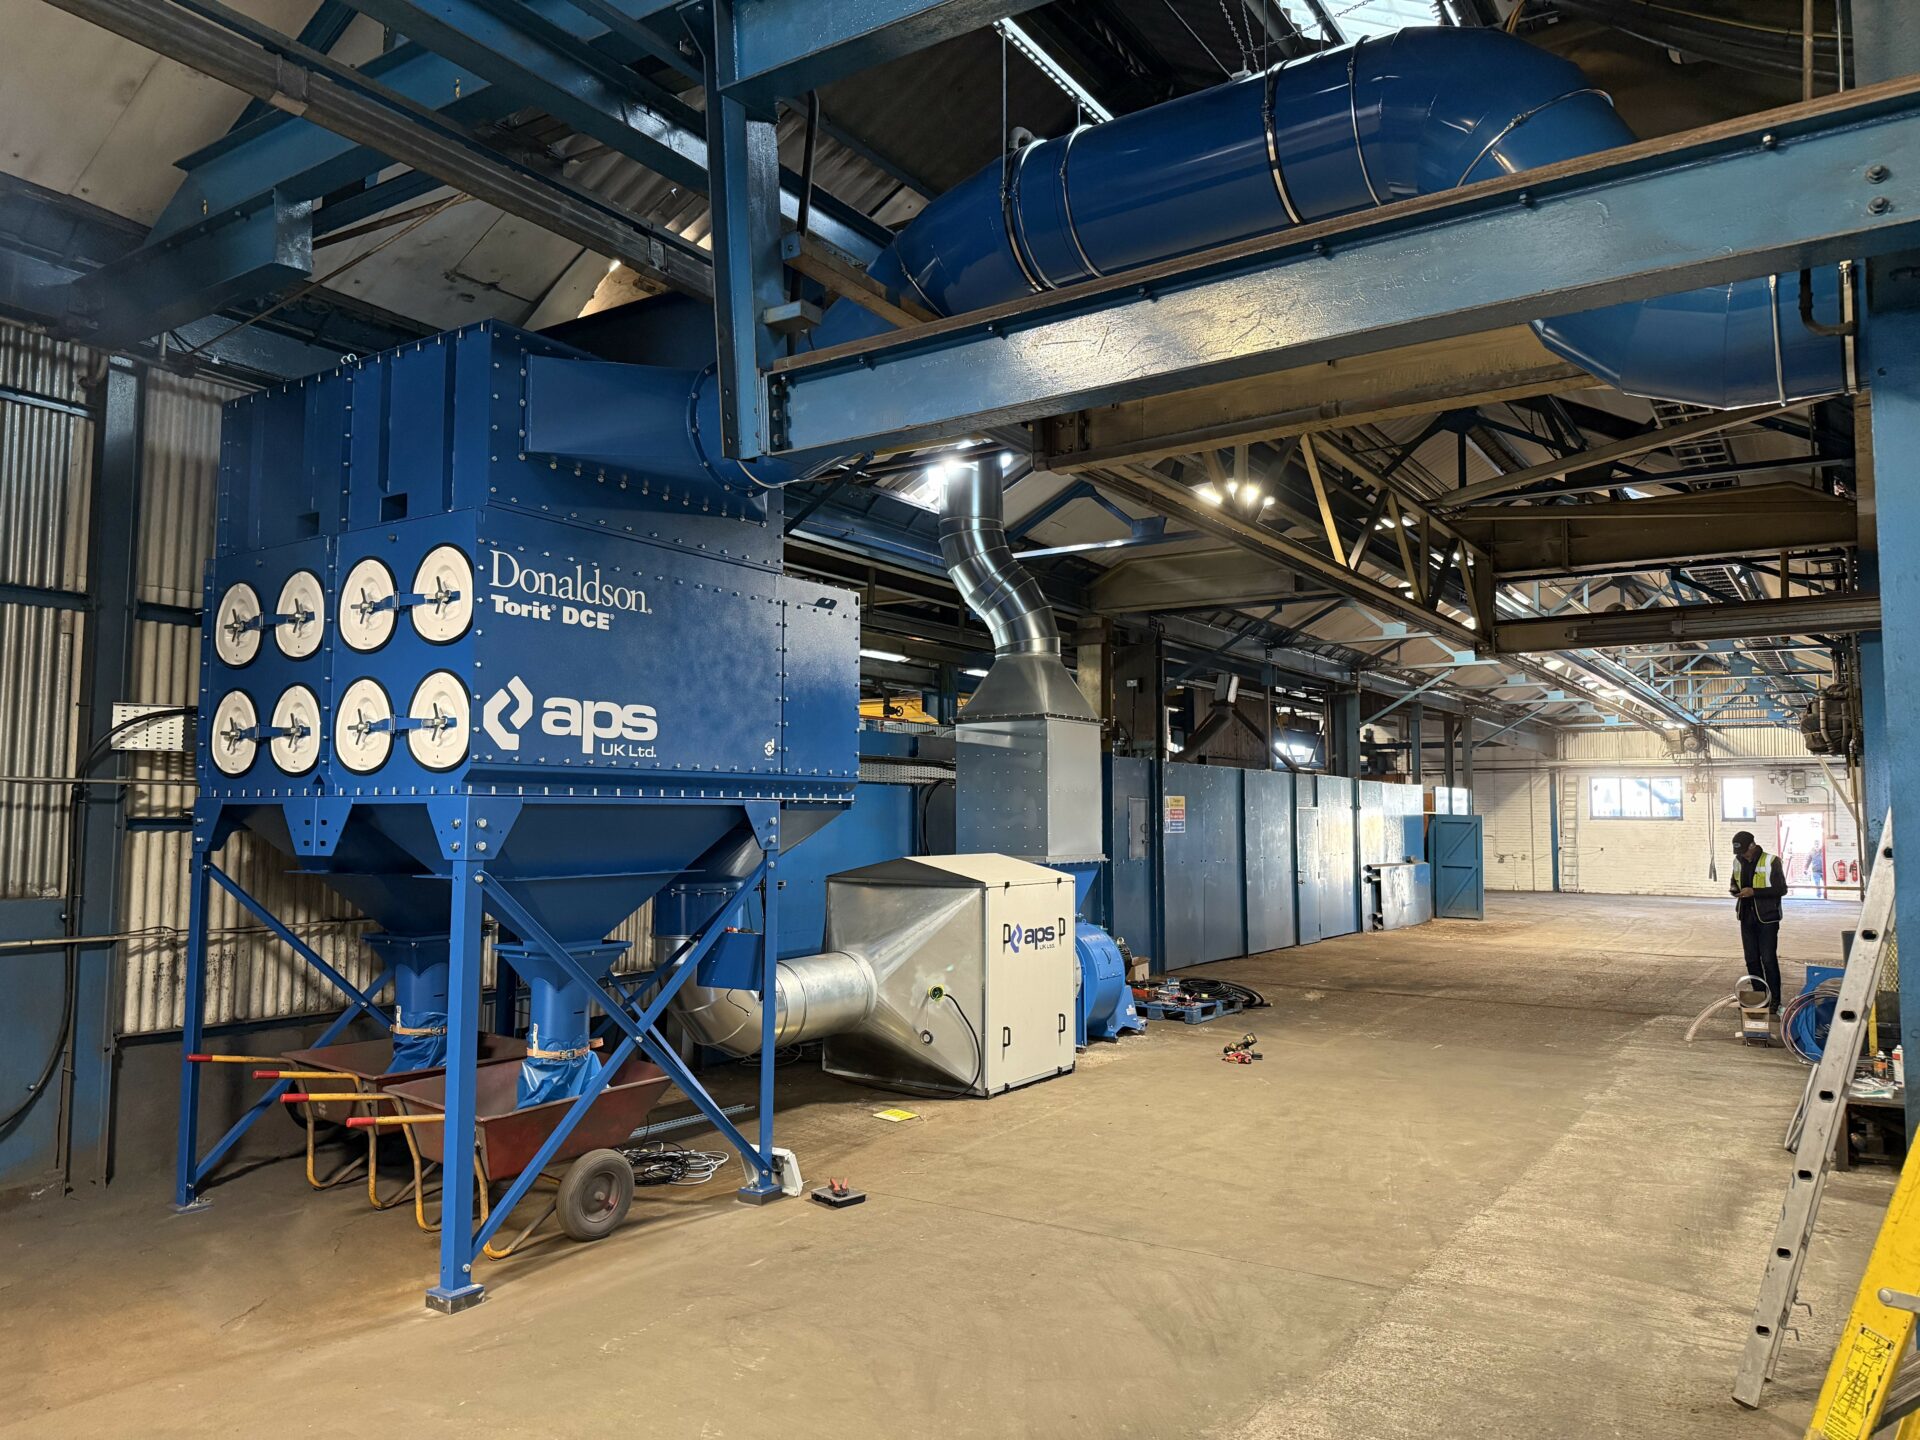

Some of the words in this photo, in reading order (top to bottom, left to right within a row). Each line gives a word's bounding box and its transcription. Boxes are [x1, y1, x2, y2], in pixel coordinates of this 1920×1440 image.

[542, 697, 658, 754] aps
[601, 744, 626, 757] UK
[629, 745, 657, 758] Ltd.
[1024, 926, 1055, 950] aps
